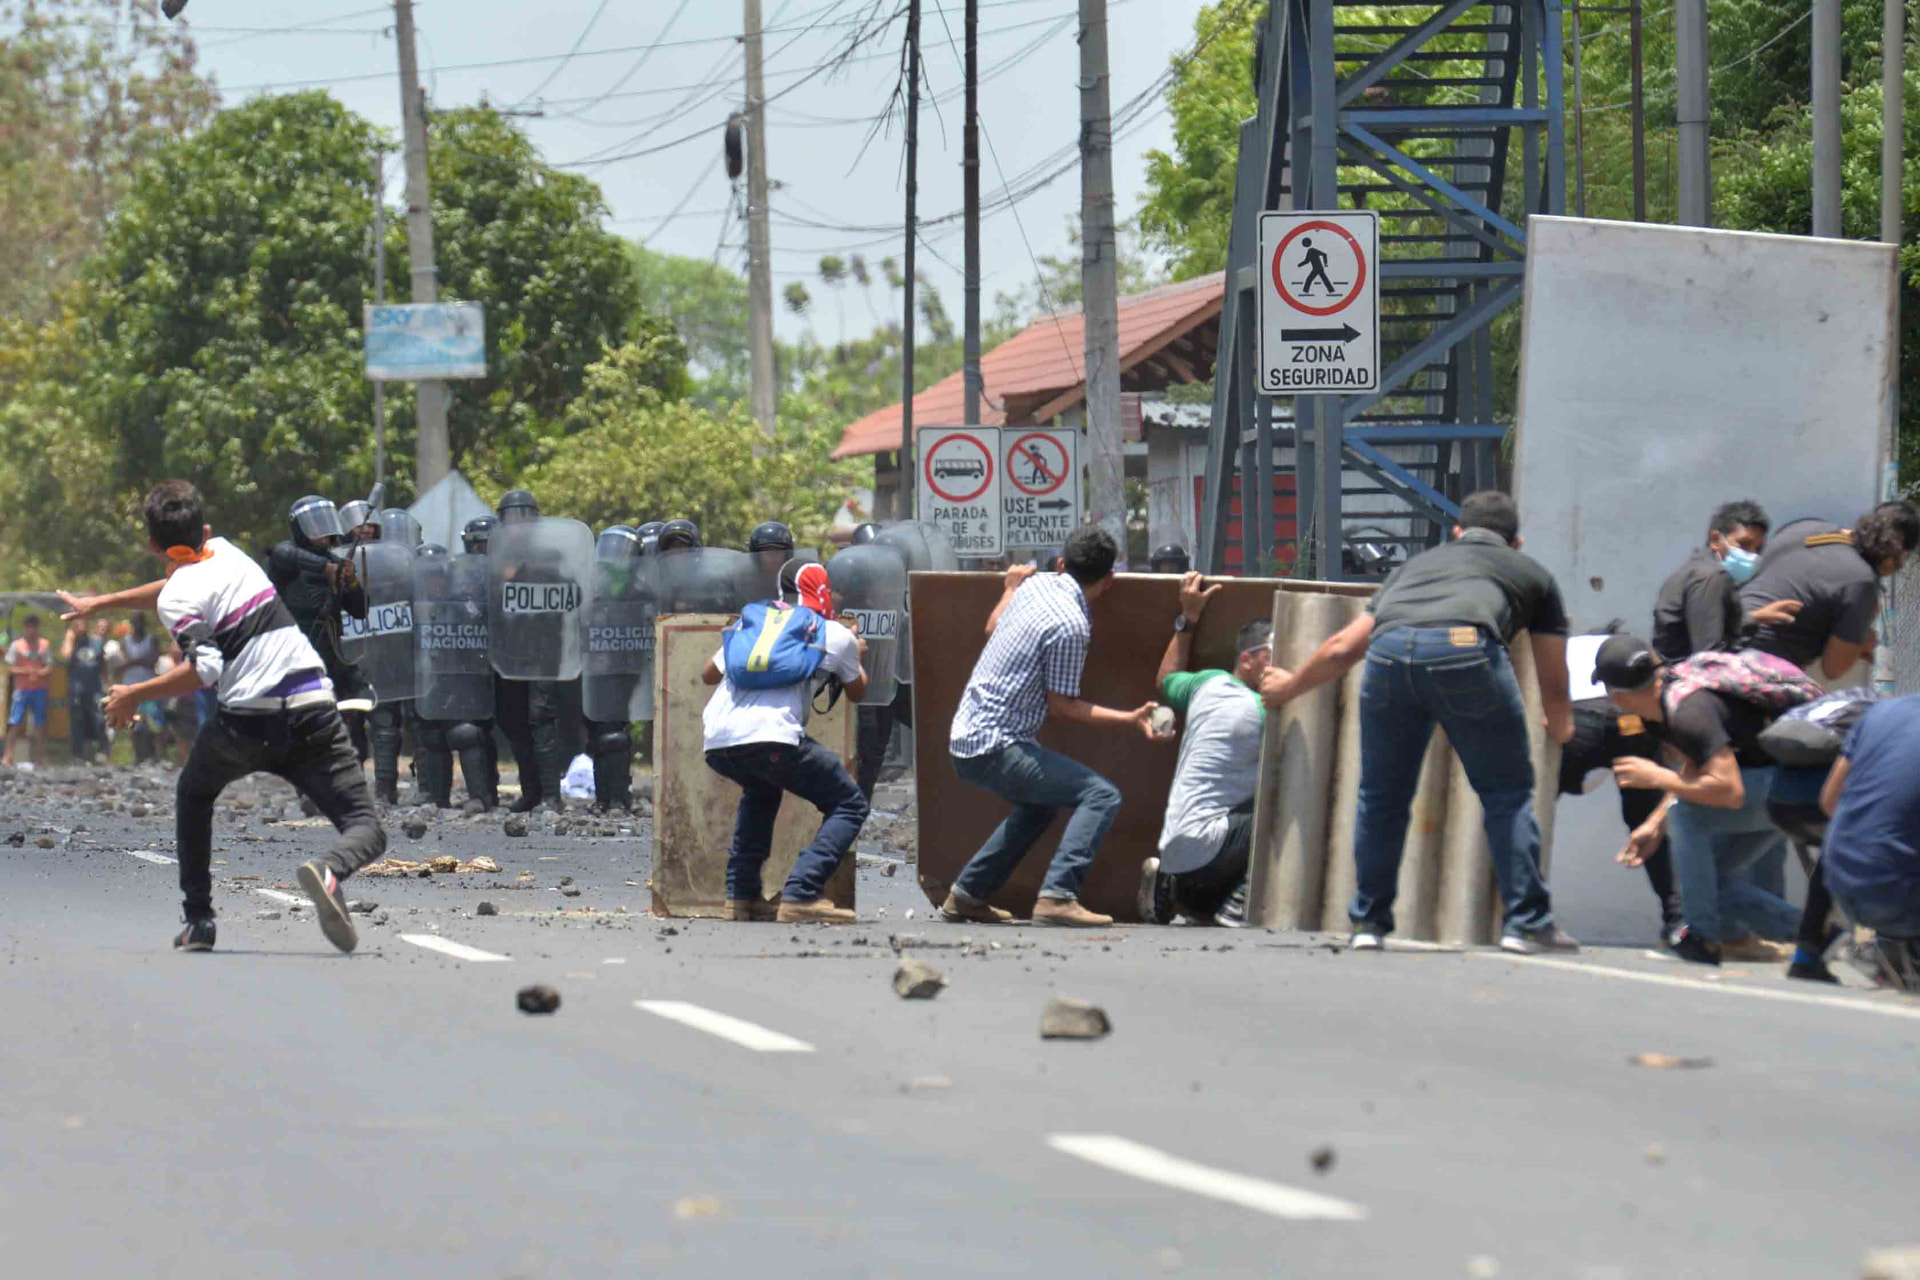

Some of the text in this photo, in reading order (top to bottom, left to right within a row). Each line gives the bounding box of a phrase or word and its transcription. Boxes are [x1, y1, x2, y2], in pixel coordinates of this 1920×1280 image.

[1291, 345, 1345, 362] ZONA
[1270, 367, 1368, 385] SEGURIDAD
[1004, 498, 1035, 513] USE
[934, 507, 989, 520] PARADA
[952, 522, 968, 533] DE
[1007, 515, 1070, 528] PUENTE
[504, 585, 575, 611] POLICIA
[421, 624, 487, 636] POLICIA
[844, 612, 896, 636] OLICIA
[589, 639, 653, 651] NACIONA
